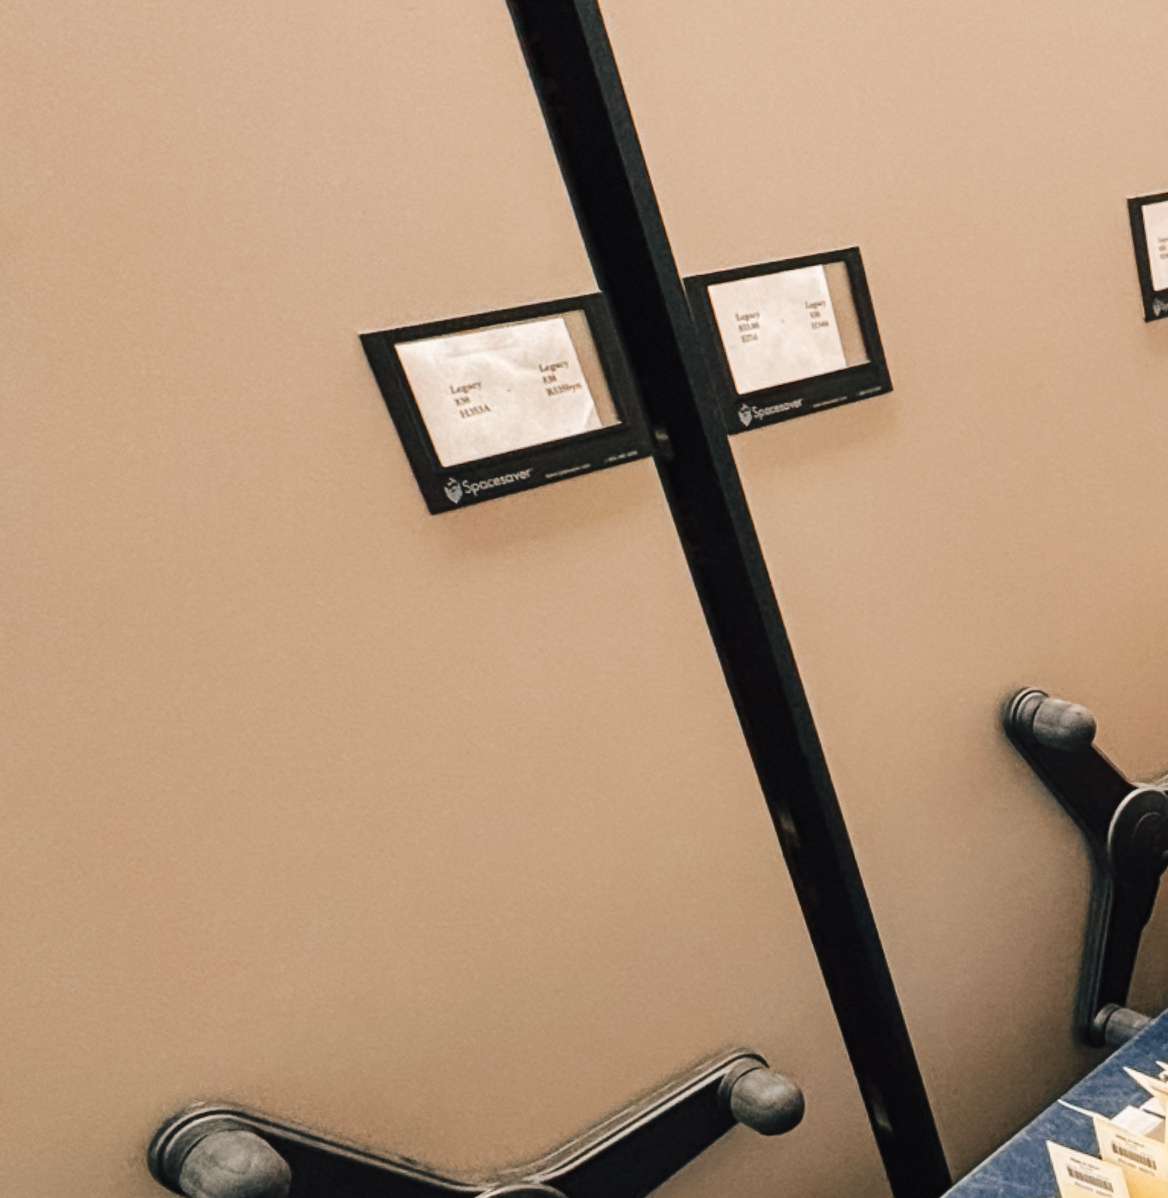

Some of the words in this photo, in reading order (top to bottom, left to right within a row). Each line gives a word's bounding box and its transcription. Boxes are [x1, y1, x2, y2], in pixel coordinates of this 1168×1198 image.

[538, 360, 570, 373] Legacy
[449, 381, 482, 395] Legacy
[751, 398, 803, 420] Spacesaver
[462, 467, 533, 496] Spacesaver
